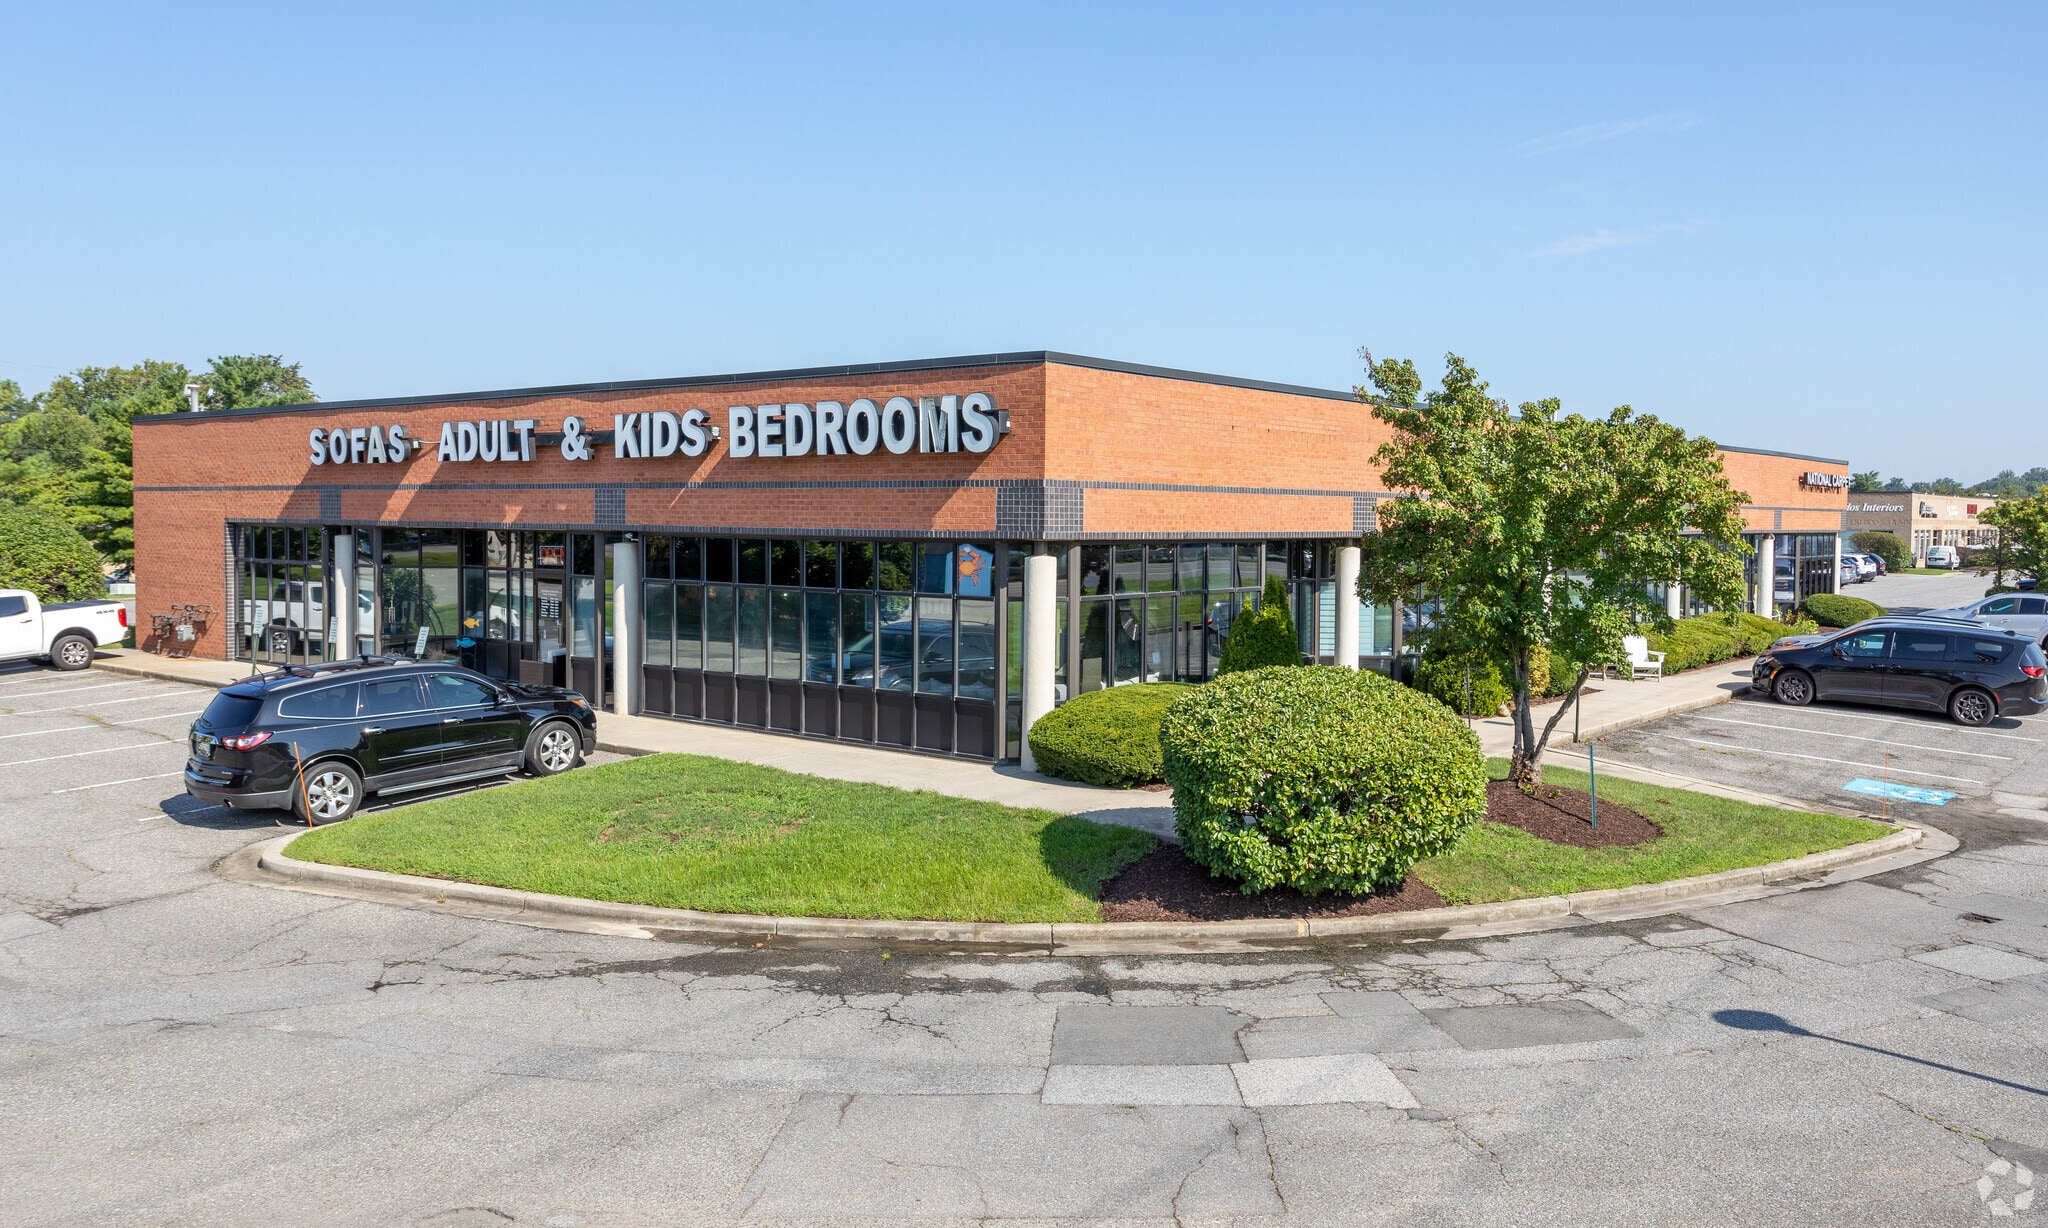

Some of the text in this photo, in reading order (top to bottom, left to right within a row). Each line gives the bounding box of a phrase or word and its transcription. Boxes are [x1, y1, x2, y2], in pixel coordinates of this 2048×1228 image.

[309, 392, 1000, 466] SOFAS ADULT & KIDS BEDROOMS
[1807, 471, 1832, 487] NATIONAL
[1862, 502, 1904, 512] Interiors
